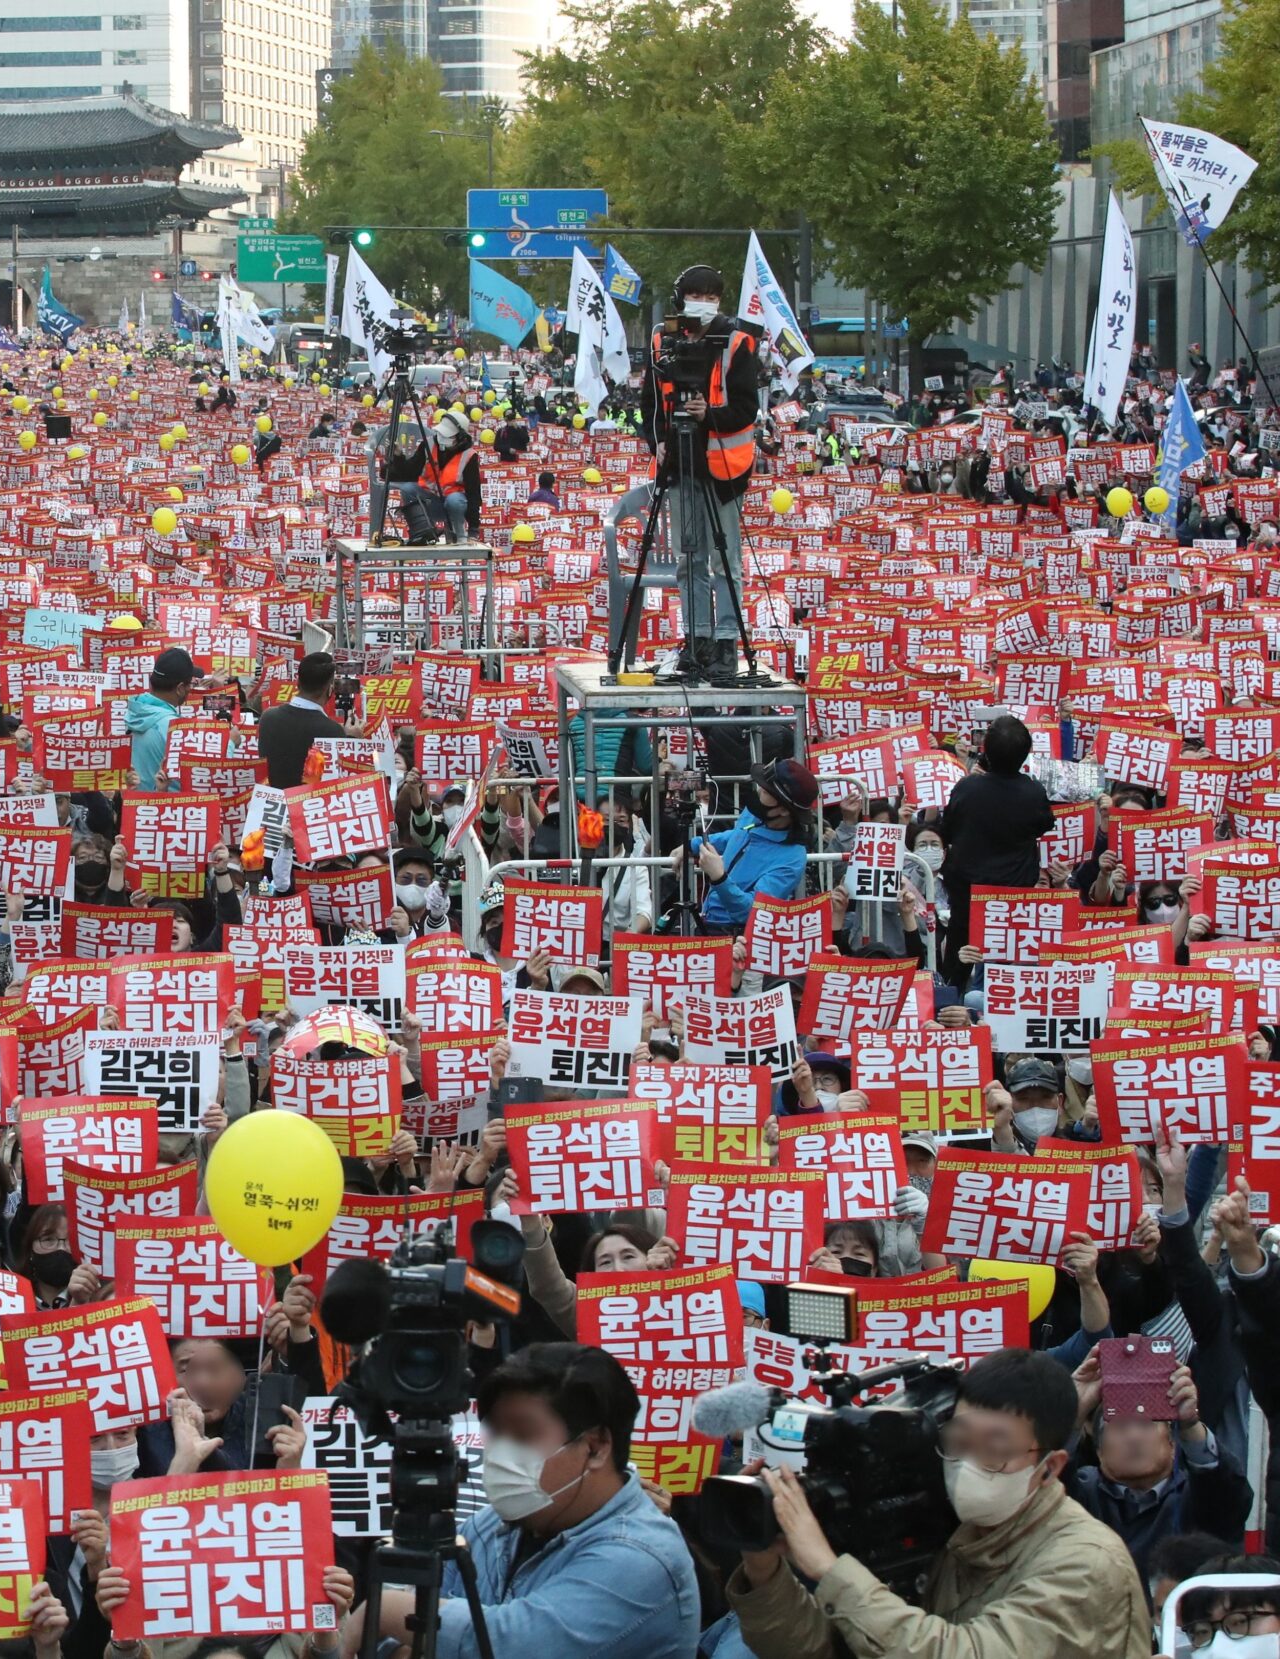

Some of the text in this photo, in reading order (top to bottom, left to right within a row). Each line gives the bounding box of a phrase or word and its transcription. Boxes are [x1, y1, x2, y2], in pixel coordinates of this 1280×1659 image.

[502, 195, 526, 204] 서울역
[1004, 661, 1061, 683] 윤석열
[1003, 681, 1062, 705] 퇴진!
[422, 733, 482, 755] 윤석열
[1106, 730, 1170, 763] 윤석열
[45, 749, 112, 771] 김건희
[422, 755, 481, 780] 퇴진!
[72, 769, 128, 790] 특검!
[513, 992, 629, 1017] 무능 무지 거짓말
[685, 991, 784, 1016] 무능 무지 거짓말
[88, 1033, 218, 1051] 주가조작 허위경력 상습사기
[100, 1050, 200, 1084] 김건희
[273, 1056, 389, 1078] 주가조작 허위경력
[635, 1065, 751, 1082] 무능 무지 거짓말
[1112, 1056, 1226, 1096] 윤석열
[273, 1075, 389, 1116] 김건희
[42, 1117, 143, 1154] 윤석열
[525, 1119, 641, 1162] 윤석열
[530, 1158, 643, 1213] 퇴진!
[954, 1171, 1070, 1222] 윤석열
[687, 1184, 805, 1229] 윤석열
[941, 1209, 1063, 1266] 퇴진!
[597, 1290, 727, 1339] 윤석열
[23, 1321, 152, 1391] 윤석열
[651, 1367, 730, 1391] 허위경력
[43, 1389, 88, 1409] 친일매국
[139, 1502, 304, 1563] 윤석열
[142, 1559, 306, 1636] 퇴진!
